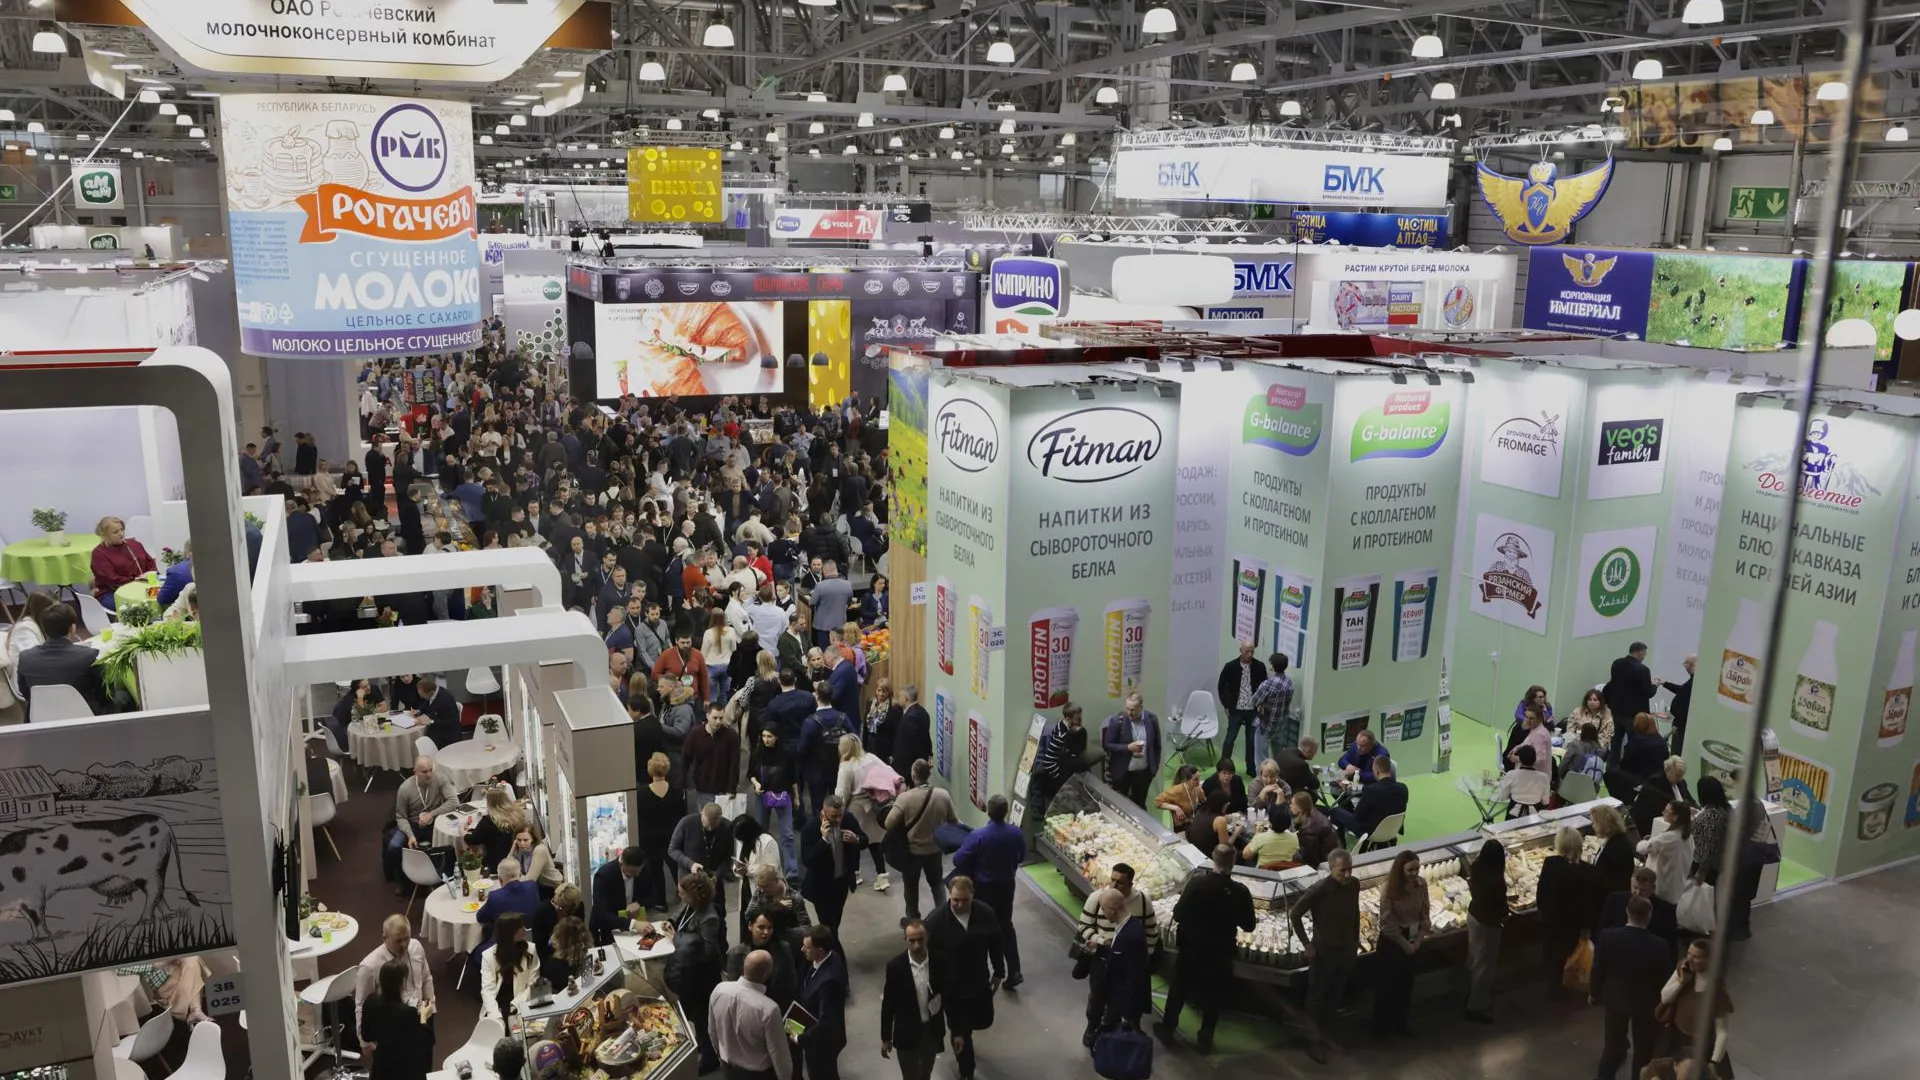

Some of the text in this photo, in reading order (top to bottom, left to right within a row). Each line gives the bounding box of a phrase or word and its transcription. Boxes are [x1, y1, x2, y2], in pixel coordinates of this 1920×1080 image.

[270, 0, 314, 16] ОАО
[206, 21, 496, 48] молочноконсервный комбинат
[322, 102, 376, 114] БЕЛАРУСЬ
[1158, 162, 1200, 187] БМК
[1323, 164, 1385, 193] БМК
[651, 180, 717, 195] ВКУСА
[1397, 217, 1438, 232] ЧАСТИЦА
[1396, 231, 1429, 245] АЛТАЯ
[350, 248, 467, 268] СГУЩЕННОЕ
[1345, 264, 1470, 273] РАСТИМ КРУТОЙ БРЕНД МОЛОКА
[314, 266, 479, 311] МОЛОКО
[995, 273, 1055, 300] КИПРИНО
[1560, 290, 1612, 303] КОРПОРАЦИЯ
[1211, 311, 1260, 319] МОЛОКО
[1549, 300, 1622, 320] ИМПЕРИАЛ
[346, 315, 412, 328] ЦЕЛЬНОЕ
[417, 313, 424, 325] С
[272, 337, 331, 353] МОЛОКО
[334, 336, 404, 354] ЦЕЛЬНОЕ
[407, 331, 471, 349] СГУЩЕННОЕ
[1271, 396, 1298, 409] product
[1276, 387, 1302, 399] Natural
[1388, 402, 1421, 413] product
[1250, 411, 1312, 440] G-balance
[1361, 424, 1439, 442] G-balance
[1506, 429, 1532, 439] province
[940, 412, 997, 465] Fitman
[1605, 424, 1658, 449] veg's
[1039, 427, 1156, 477] Fitman
[1498, 437, 1548, 457] FROMAGE
[1607, 443, 1652, 465] family
[1253, 471, 1302, 497] ПРОДУКТЫ
[1366, 482, 1426, 502] ПРОДУКТЫ
[939, 487, 993, 523] НАПИТКИ ИЗ
[1242, 491, 1311, 524] С КОЛЛАГЕНОМ
[1695, 495, 1703, 508] И
[1039, 504, 1151, 529] НАПИТКИ ИЗ
[1350, 505, 1437, 527] С КОЛЛАГЕНОМ
[935, 510, 994, 551] СЫВОРОТОЧНОГО
[1244, 515, 1309, 548] И ПРОТЕИНОМ
[1353, 528, 1433, 551] И ПРОТЕИНОМ
[1741, 509, 1866, 553] НАЦИНАЛЬНЫЕ
[1030, 529, 1153, 557] СЫВОРОТОЧНОГО
[953, 544, 976, 569] БЕЛКА
[1792, 547, 1862, 580] КАВКАЗА
[1072, 560, 1116, 579] БЕЛКА
[1488, 574, 1533, 598] РЯЗАНСКИЙ
[1735, 558, 1858, 607] И СРЕНЕЙ АЗИИ
[1240, 593, 1255, 606] ТАН
[945, 607, 954, 625] 30
[1346, 616, 1364, 628] ТАН
[1402, 609, 1424, 619] КЕФИР
[980, 628, 989, 647] 30
[990, 639, 1005, 647] 020
[1051, 636, 1071, 653] 30
[1125, 626, 1143, 643] 30
[1034, 627, 1048, 706] PROTEIN
[1108, 619, 1121, 695] PROTEIN
[945, 716, 953, 735] 30
[210, 994, 241, 1009] 025
